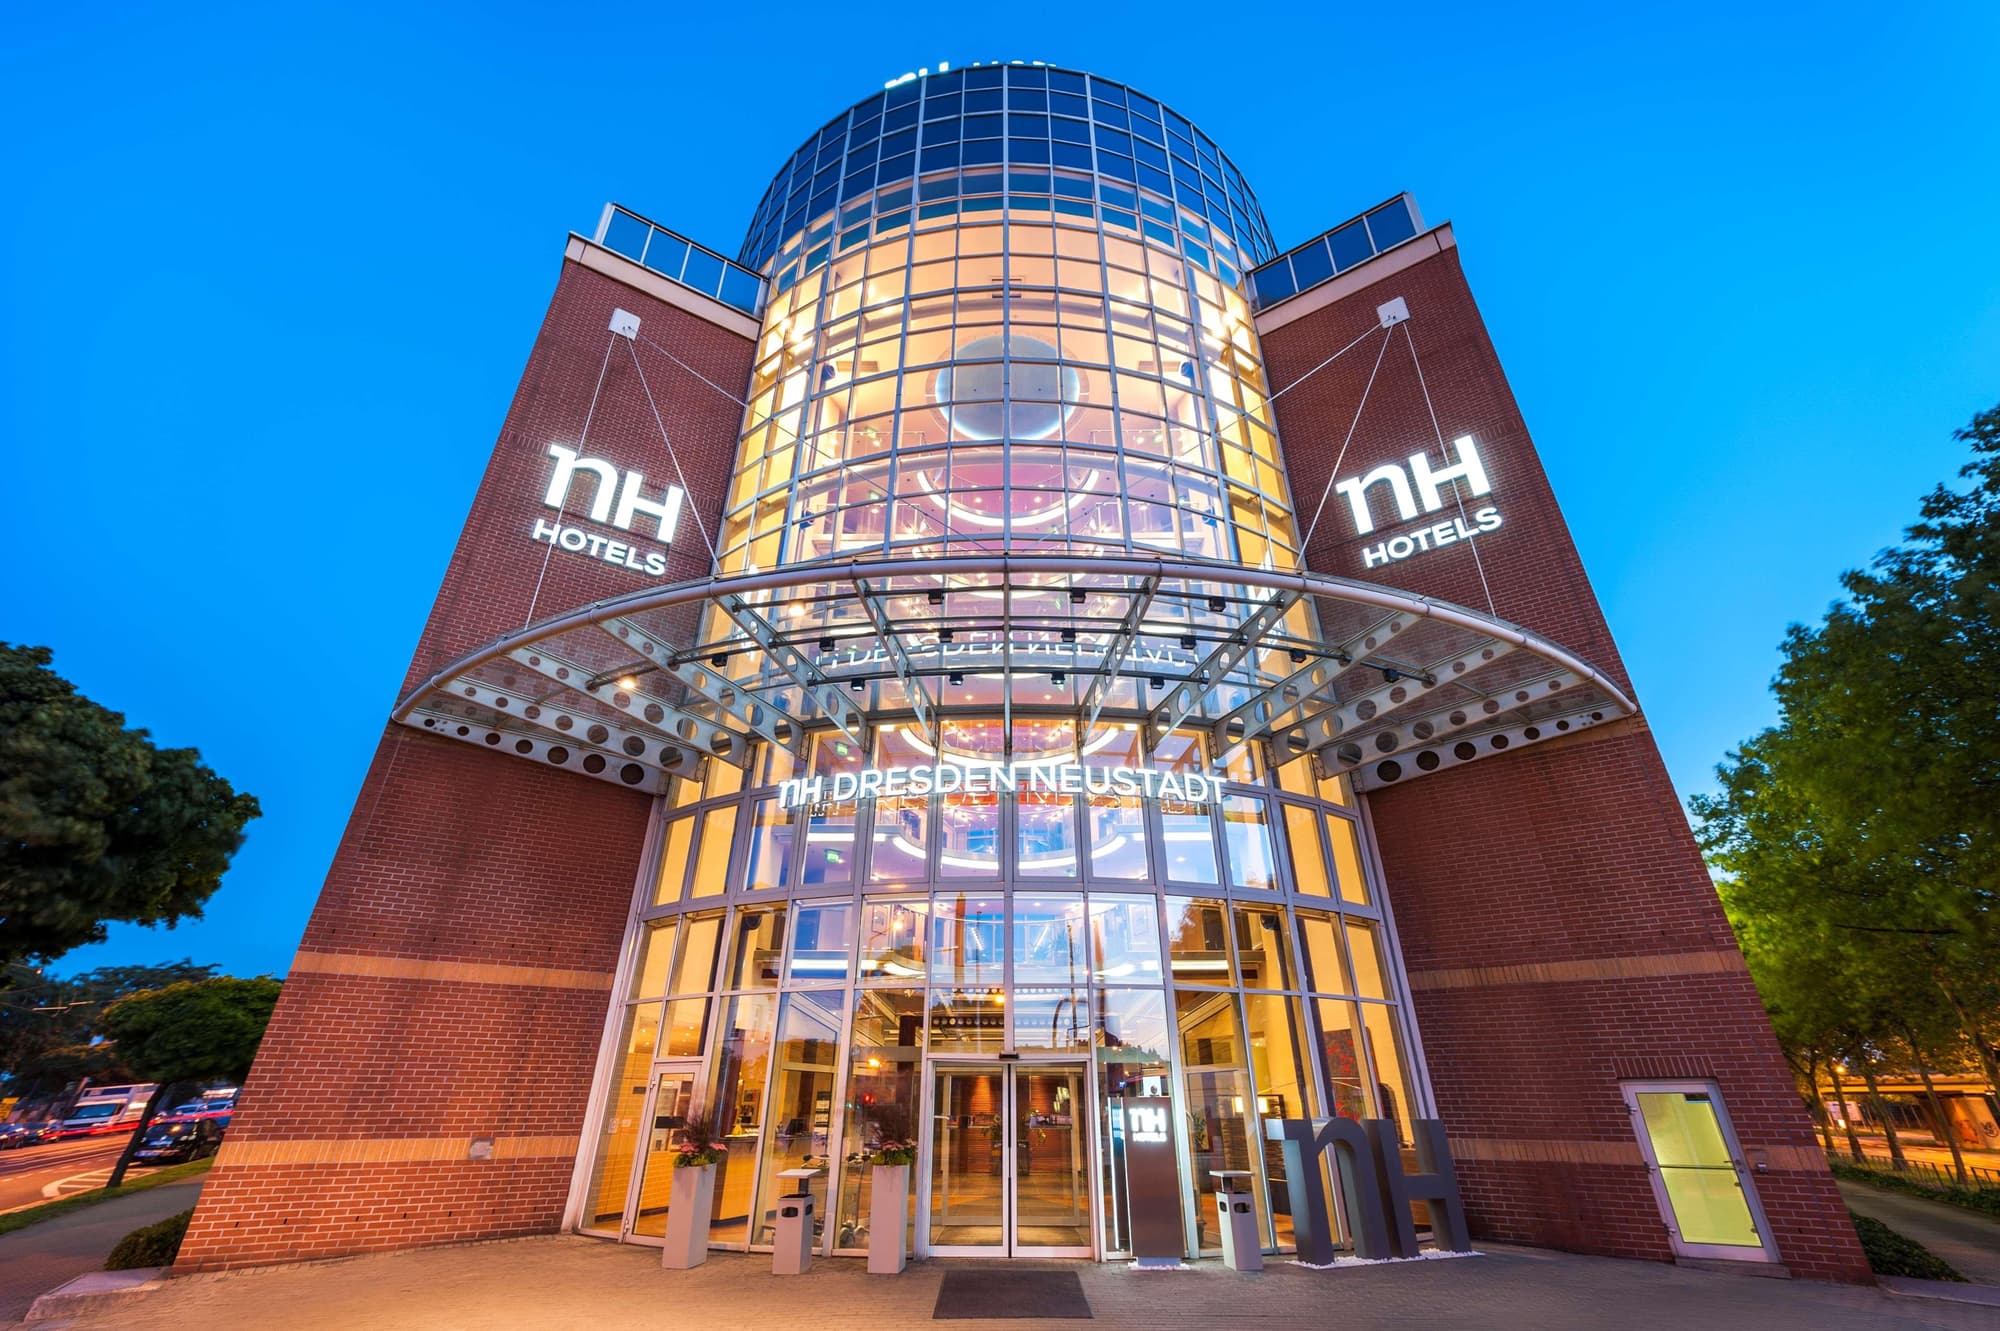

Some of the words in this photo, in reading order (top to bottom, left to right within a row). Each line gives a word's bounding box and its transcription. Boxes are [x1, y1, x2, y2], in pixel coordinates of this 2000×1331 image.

[531, 518, 667, 577] HOTELS
[1362, 506, 1503, 569] HOTELS
[833, 764, 1017, 802] DRESDEN
[1029, 764, 1227, 804] NEUSTADT
